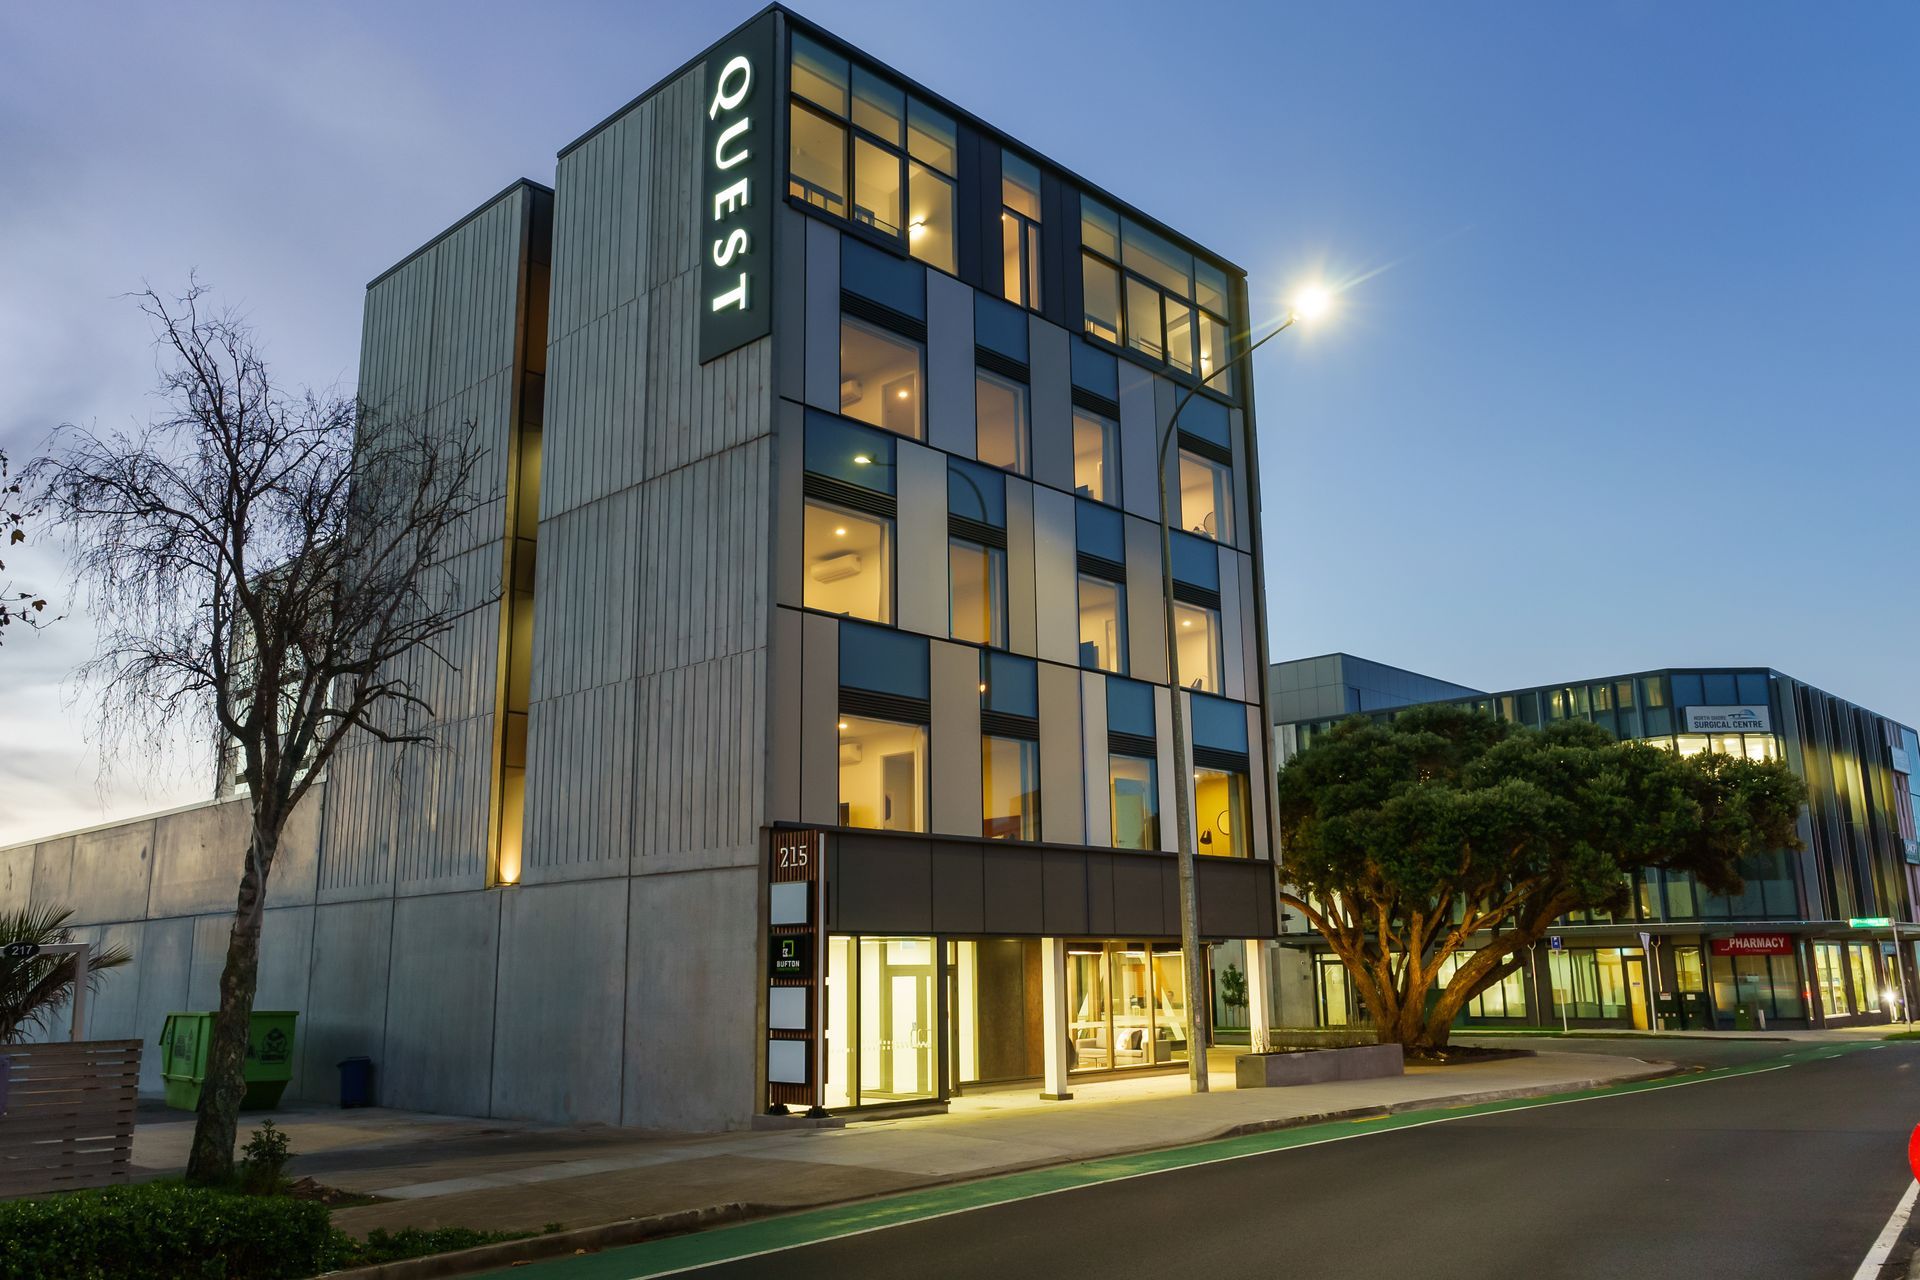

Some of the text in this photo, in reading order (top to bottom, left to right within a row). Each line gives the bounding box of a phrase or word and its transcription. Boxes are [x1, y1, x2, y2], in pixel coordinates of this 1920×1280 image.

[709, 55, 752, 312] QUEST
[1733, 720, 1763, 728] CENTRE
[780, 845, 808, 868] 215
[1729, 937, 1785, 948] PHARMACY
[11, 945, 33, 956] 217
[776, 960, 800, 968] BUFTON
